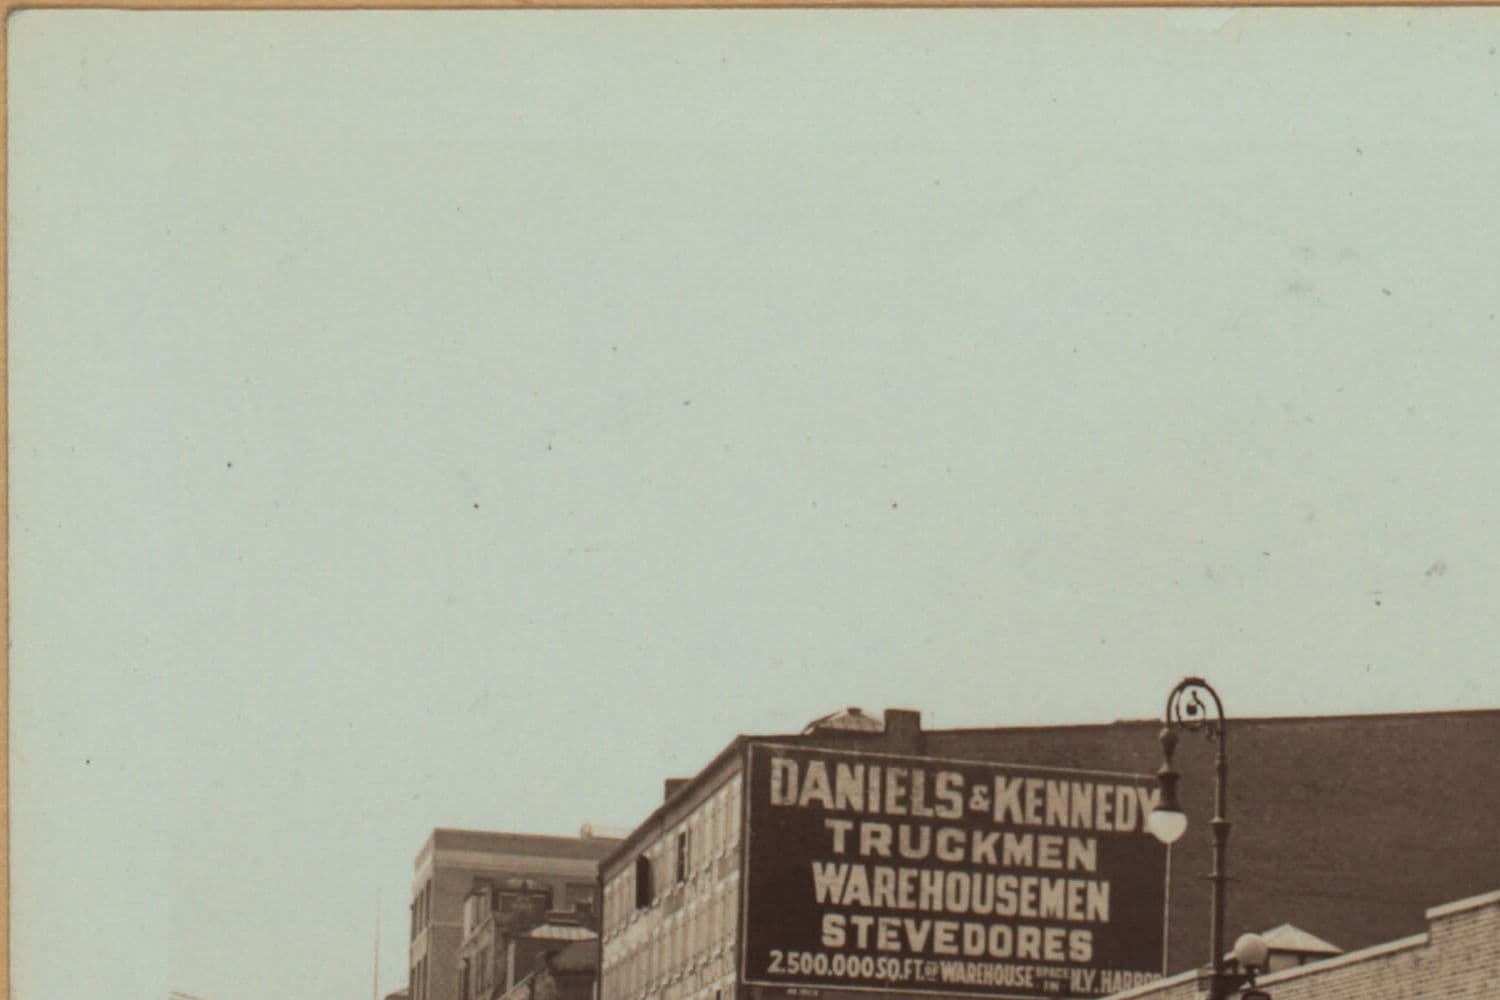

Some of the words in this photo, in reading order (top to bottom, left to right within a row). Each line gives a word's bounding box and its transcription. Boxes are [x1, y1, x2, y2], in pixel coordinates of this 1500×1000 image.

[770, 757, 964, 820] DANIELS
[969, 783, 990, 812] &
[993, 775, 1162, 833] KENNEDY
[825, 818, 1098, 872] TRUCKMEN
[812, 862, 1111, 923] WAREHOUSEMEN
[821, 914, 1094, 962] STEVEDORES
[940, 961, 1034, 989] WAREHOUSE
